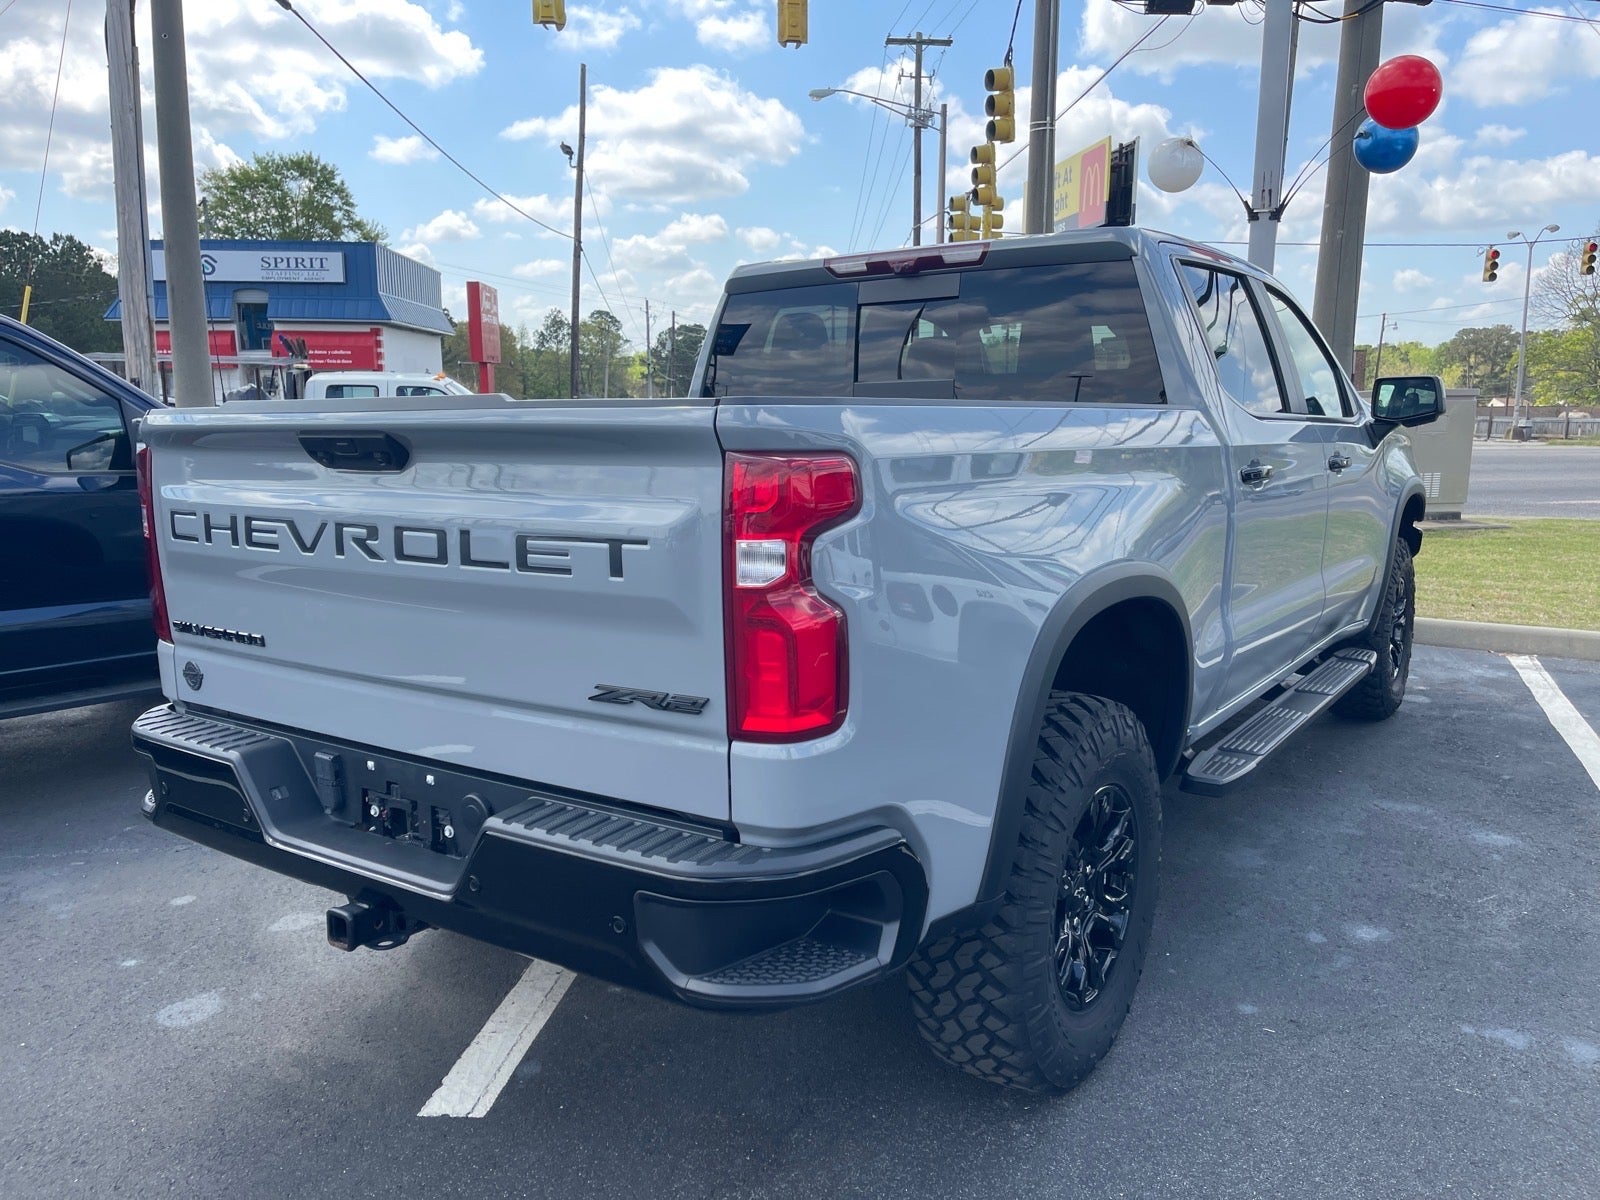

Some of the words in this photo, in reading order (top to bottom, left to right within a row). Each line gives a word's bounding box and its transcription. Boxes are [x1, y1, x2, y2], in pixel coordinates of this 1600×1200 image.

[1063, 165, 1072, 187] At
[1054, 191, 1068, 217] ght
[260, 256, 329, 269] SPIRIT
[169, 510, 650, 580] CHEVROLET
[172, 620, 266, 648] SILVERADO
[588, 683, 710, 715] ZR2
